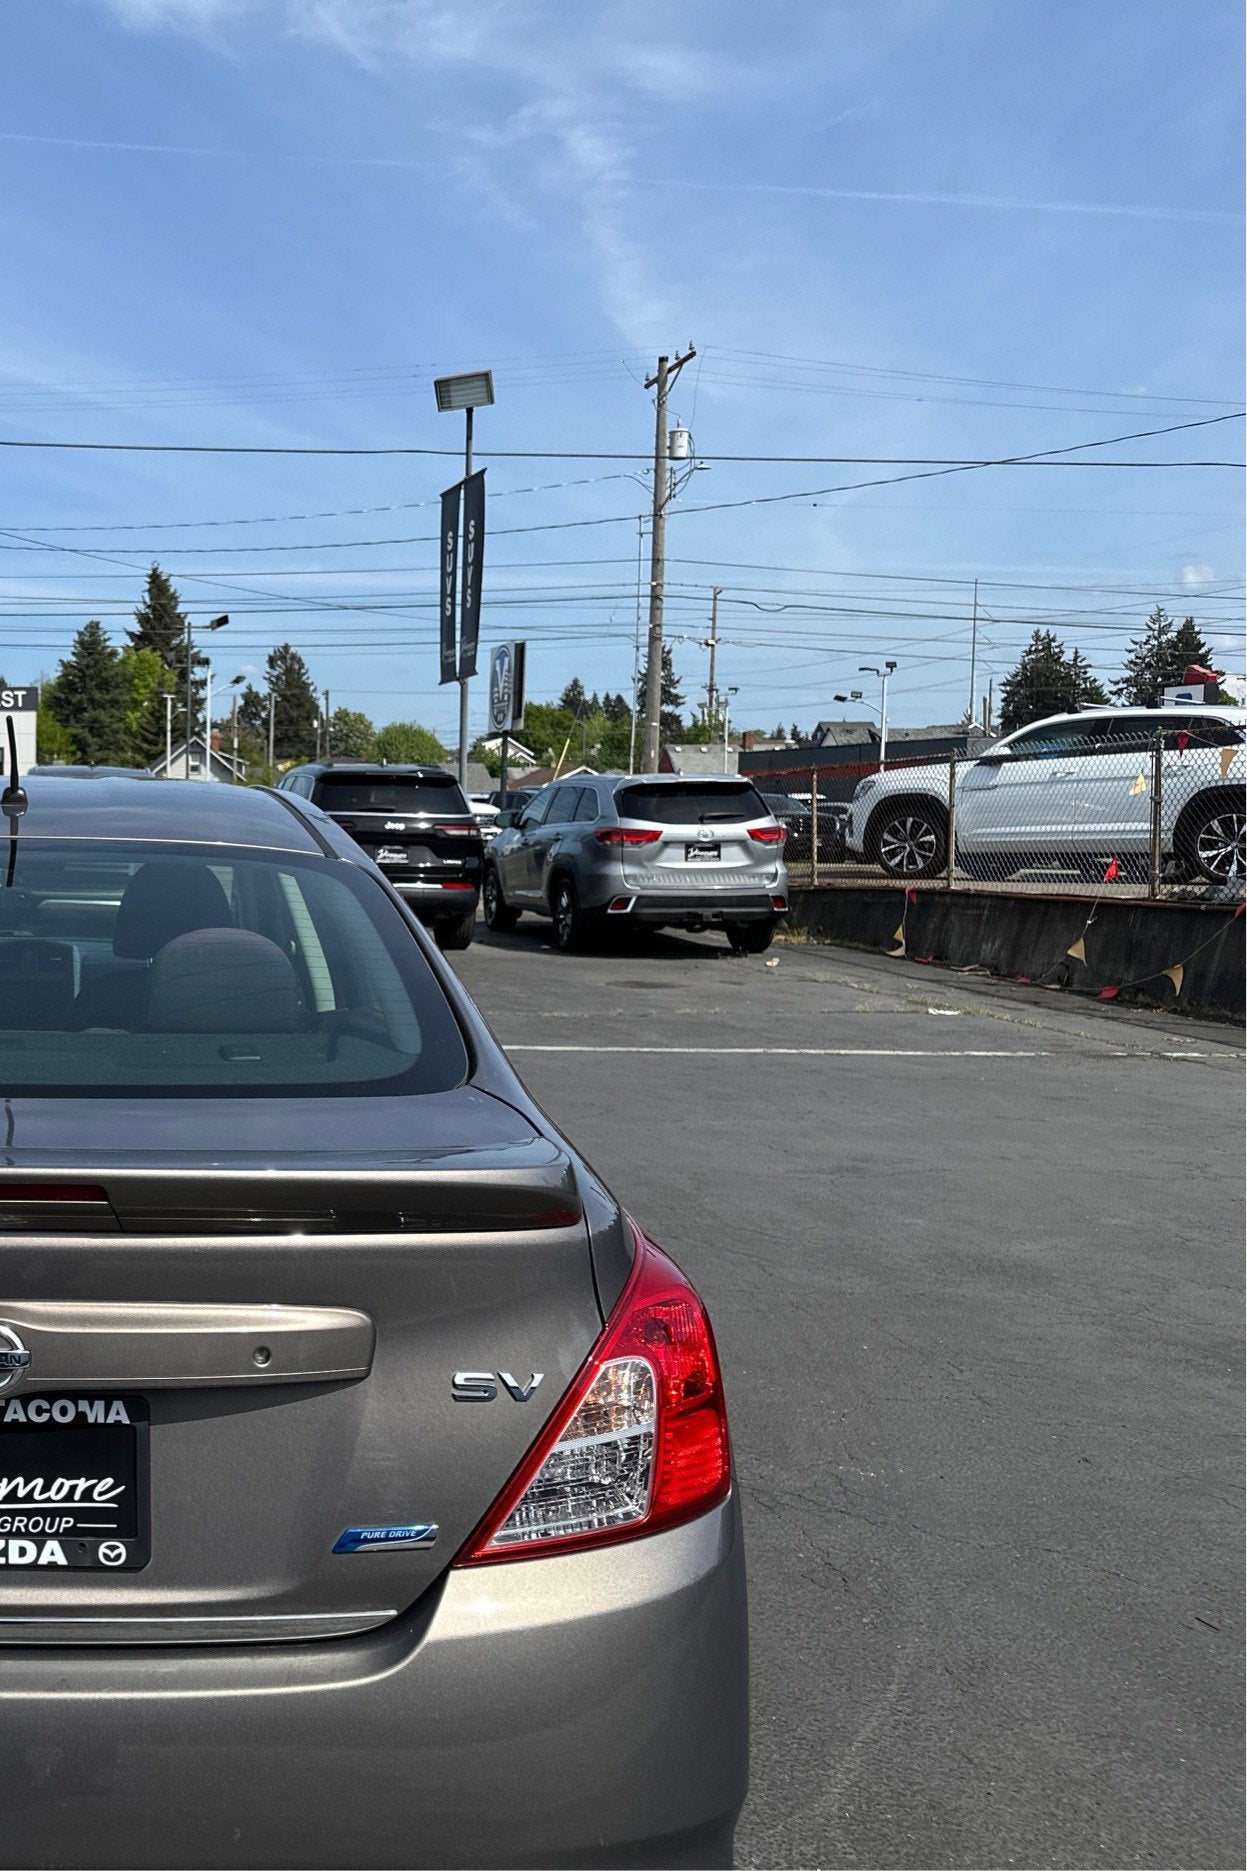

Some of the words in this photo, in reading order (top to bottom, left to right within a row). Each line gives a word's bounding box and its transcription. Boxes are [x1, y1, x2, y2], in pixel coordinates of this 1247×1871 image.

[466, 519, 475, 609] SUVS
[452, 1372, 544, 1402] SV
[360, 1530, 387, 1539] PURE
[389, 1529, 418, 1538] DRIVE
